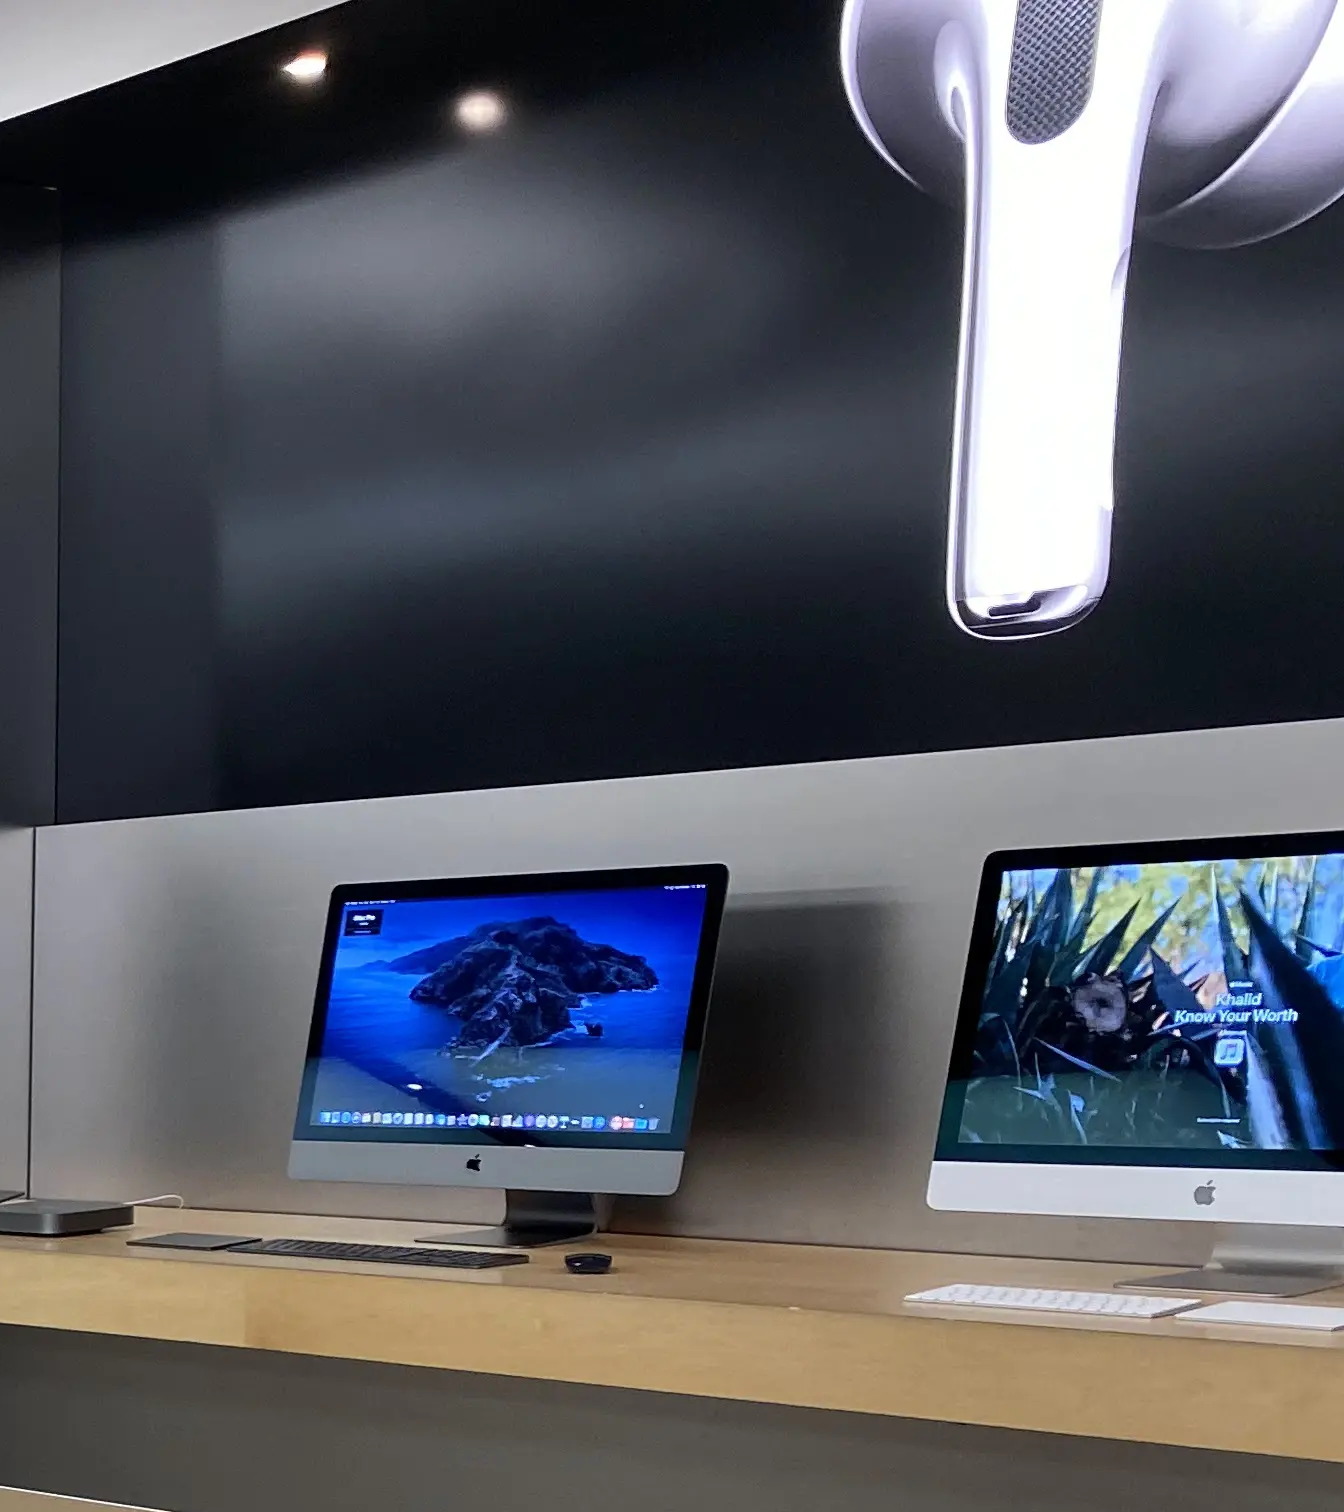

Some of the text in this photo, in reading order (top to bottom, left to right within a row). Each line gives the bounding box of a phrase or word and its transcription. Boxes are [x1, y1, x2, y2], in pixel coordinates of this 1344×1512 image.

[1216, 993, 1262, 1006] Khalid
[1175, 1008, 1299, 1023] Know Your Worth
